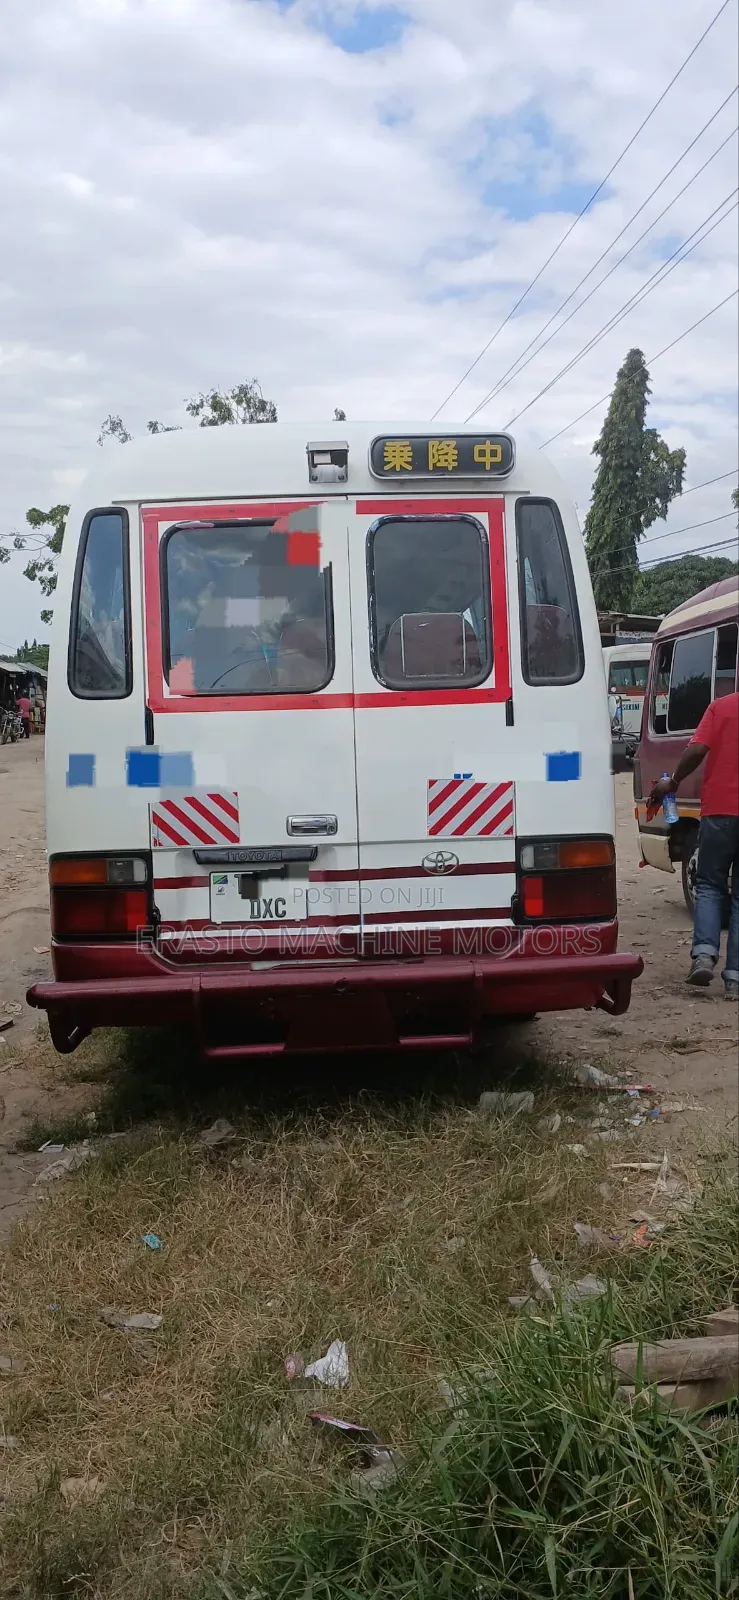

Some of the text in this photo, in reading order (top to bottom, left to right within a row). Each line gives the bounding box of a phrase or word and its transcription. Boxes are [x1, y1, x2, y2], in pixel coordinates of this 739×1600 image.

[383, 440, 502, 472] 乗降中
[233, 850, 279, 861] TOYOTA
